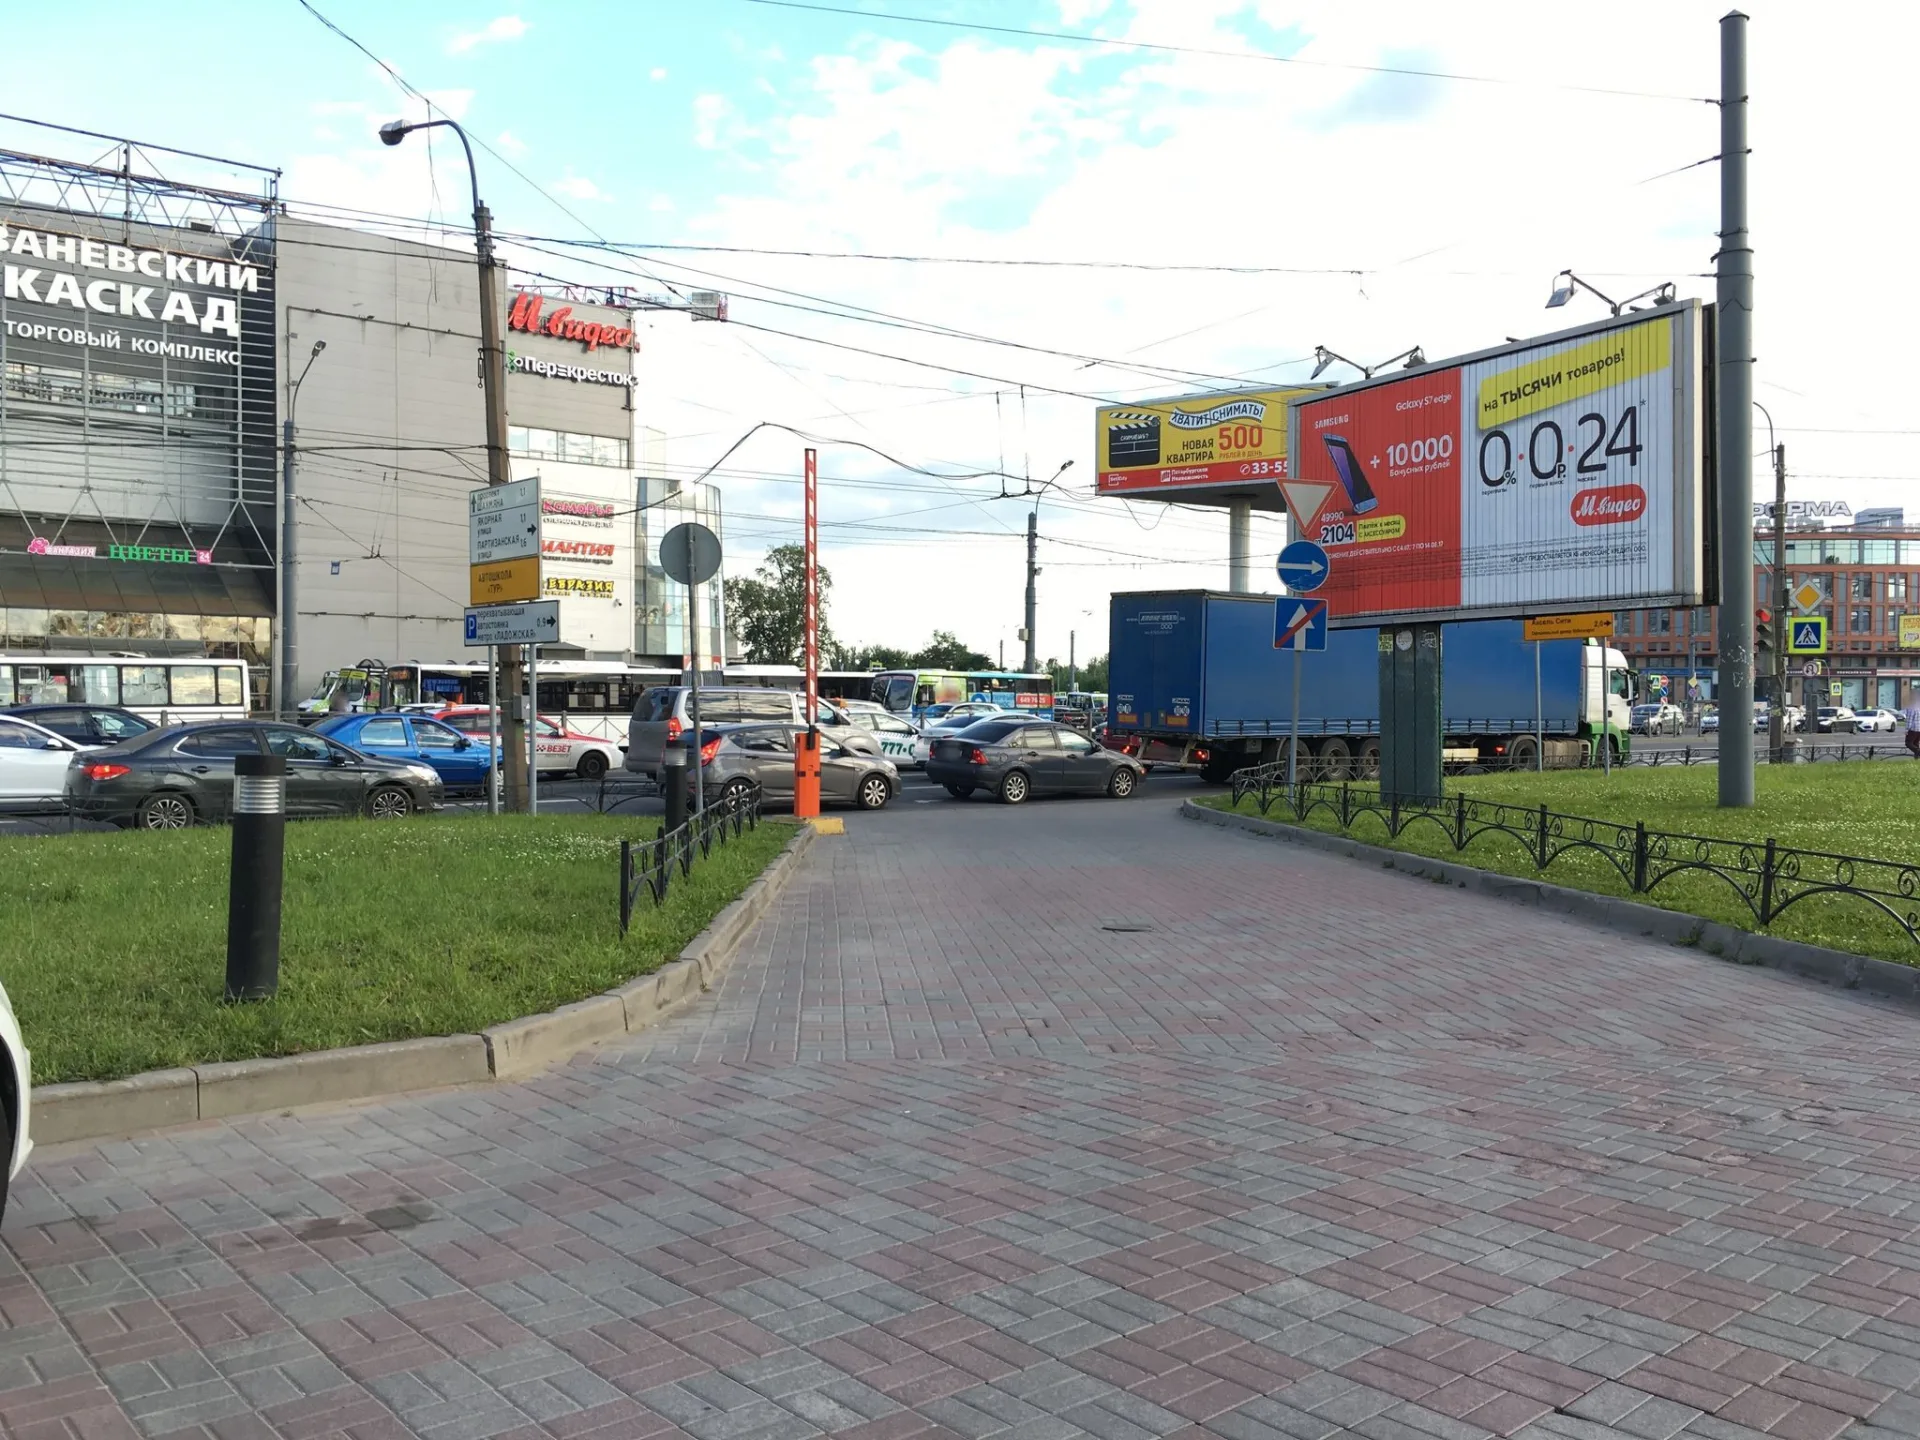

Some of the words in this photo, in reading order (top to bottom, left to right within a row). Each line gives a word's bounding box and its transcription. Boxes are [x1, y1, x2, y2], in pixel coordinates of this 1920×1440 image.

[4, 265, 240, 337] КАСКАД
[4, 320, 121, 350] ТОРГОВЫЙ
[131, 336, 241, 366] КОМПЛЕКС
[1484, 399, 1499, 412] на
[1500, 371, 1563, 405] ТЫСЯЧИ
[1566, 348, 1625, 381] товаров!
[1396, 399, 1423, 412] Galaxy
[1423, 397, 1433, 407] S7
[1434, 392, 1452, 405] edge
[1172, 411, 1210, 428] ХВАТИТ
[1211, 404, 1264, 422] СНИМАТЬ!
[1314, 414, 1349, 430] SAMSUNG
[1182, 438, 1215, 451] НОВАЯ
[1218, 424, 1263, 451] 500
[1166, 449, 1215, 465] КВАРТИРА
[1218, 451, 1241, 460] РУБЛЕЙ
[1247, 449, 1263, 458] ДЕНЬ
[1321, 511, 1344, 523] 49990
[1576, 496, 1641, 518] М.видео
[478, 534, 520, 551] ПАРТИЗАНСКАЯ
[1321, 523, 1355, 545] 2104
[110, 544, 192, 562] ЦВЕТЫ
[199, 550, 211, 561] 24
